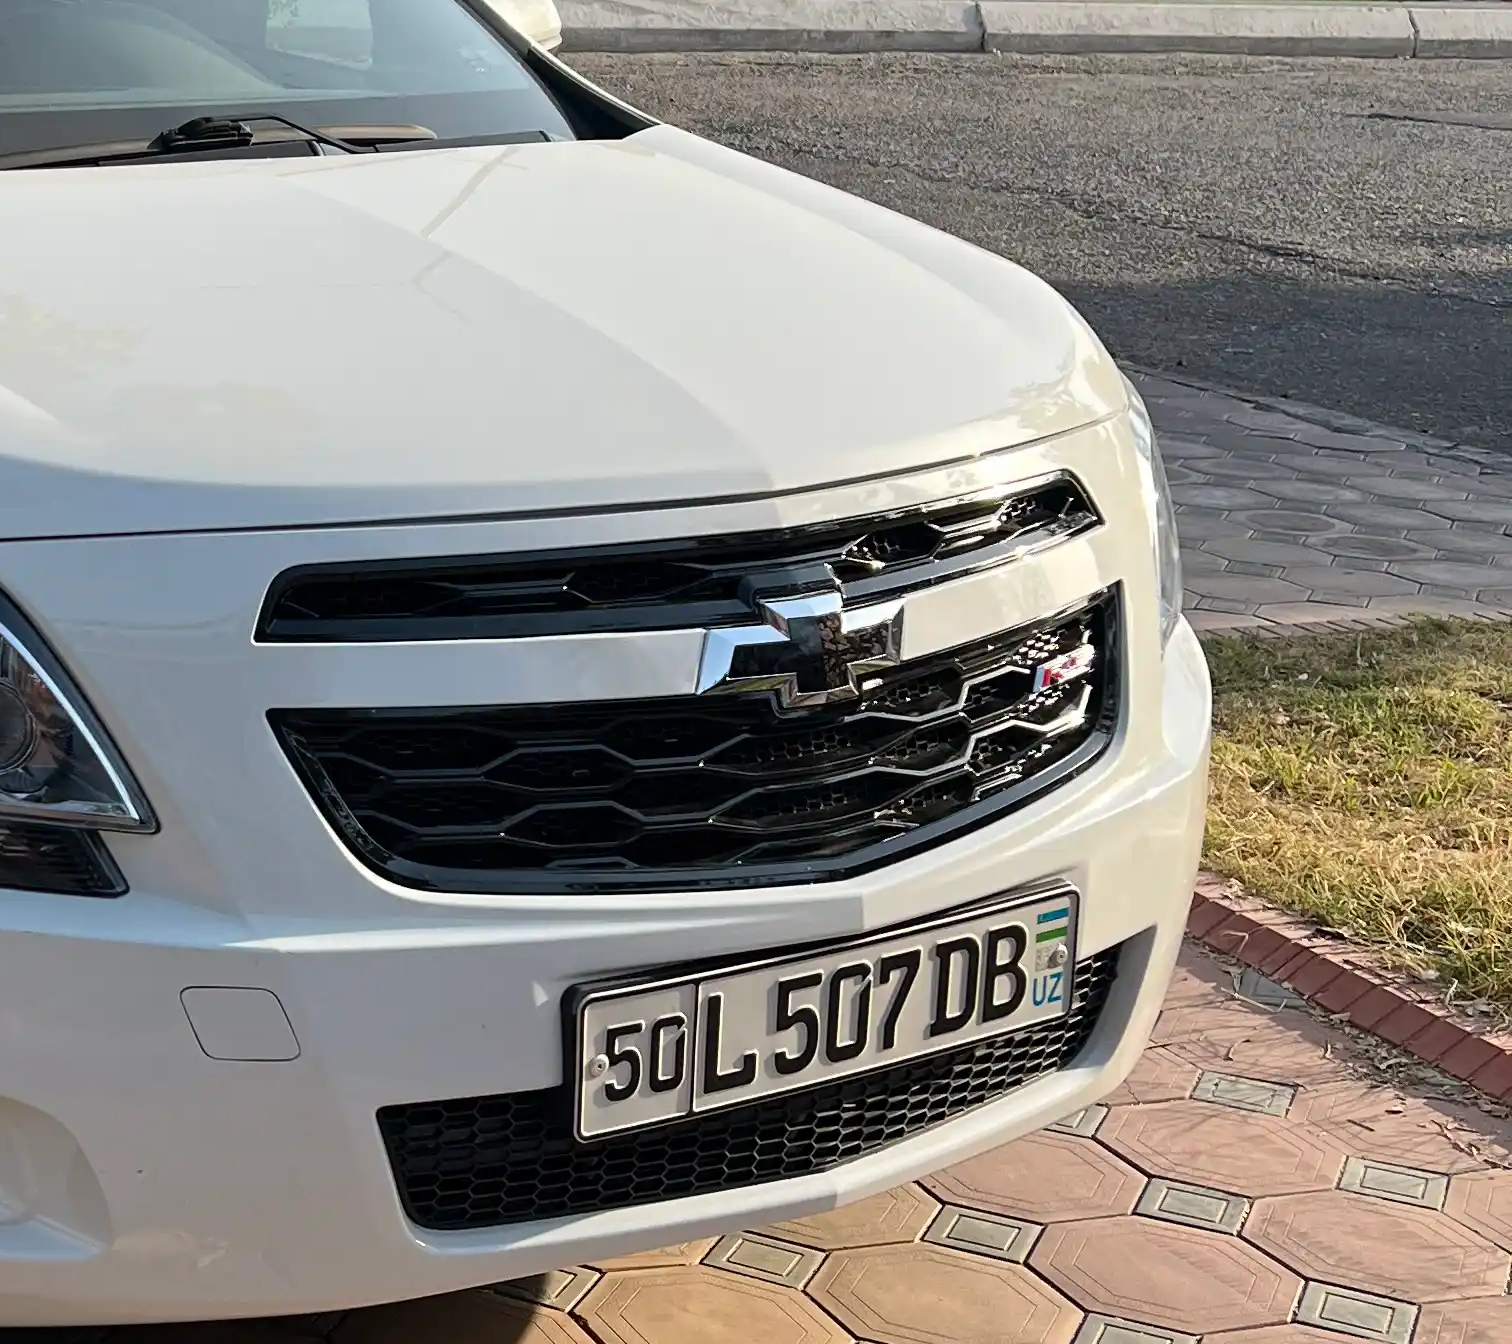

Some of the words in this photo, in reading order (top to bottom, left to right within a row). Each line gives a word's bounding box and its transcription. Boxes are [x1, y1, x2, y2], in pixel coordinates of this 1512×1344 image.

[604, 1015, 687, 1102] 50
[703, 995, 758, 1095] L
[774, 947, 923, 1075] 507
[929, 922, 1029, 1037] DB
[1032, 972, 1064, 1007] UZ
